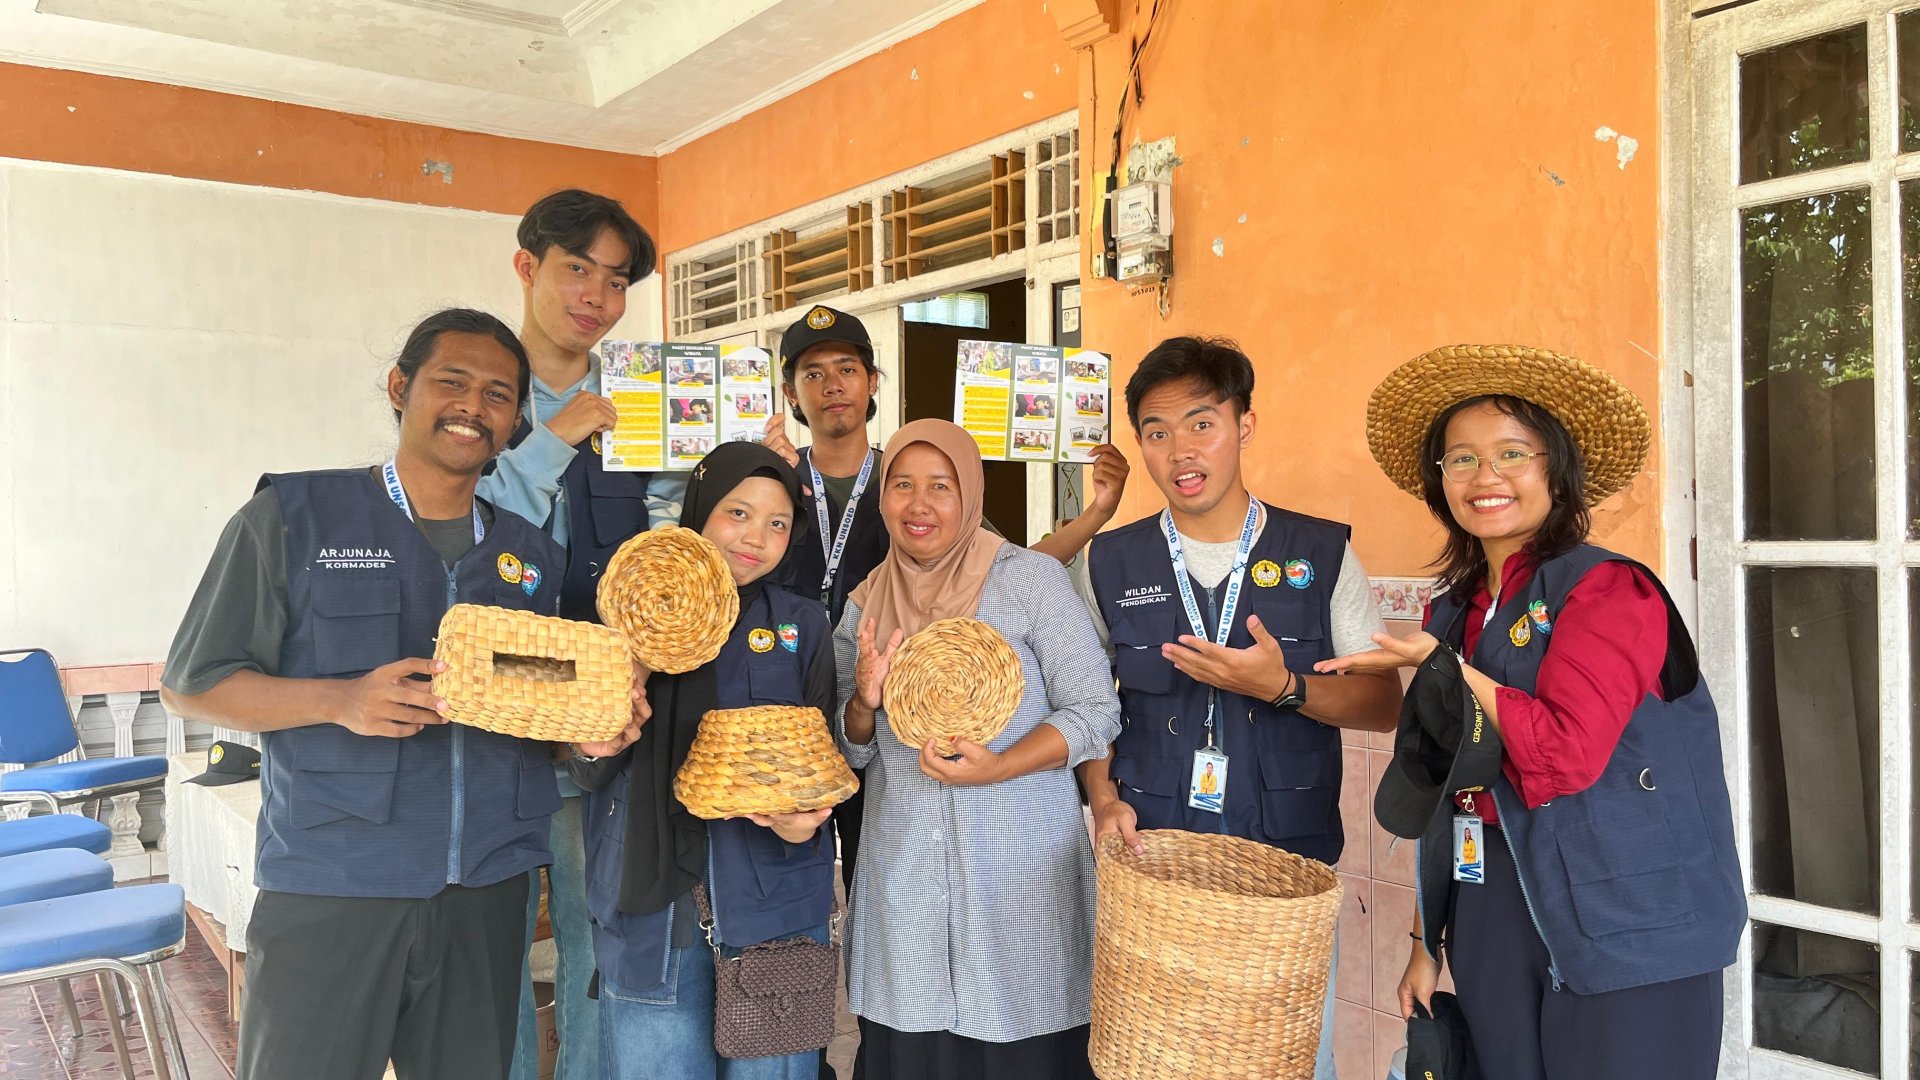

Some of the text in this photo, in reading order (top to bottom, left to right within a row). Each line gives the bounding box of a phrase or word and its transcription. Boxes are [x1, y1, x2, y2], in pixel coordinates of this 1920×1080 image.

[385, 464, 397, 485] KKN
[832, 507, 855, 560] KKN UNSOED
[319, 548, 392, 559] ARJUNAJA
[1124, 585, 1161, 597] WILDAN
[1121, 596, 1167, 608] PENDIDIKAN
[1222, 582, 1239, 625] UNSOED
